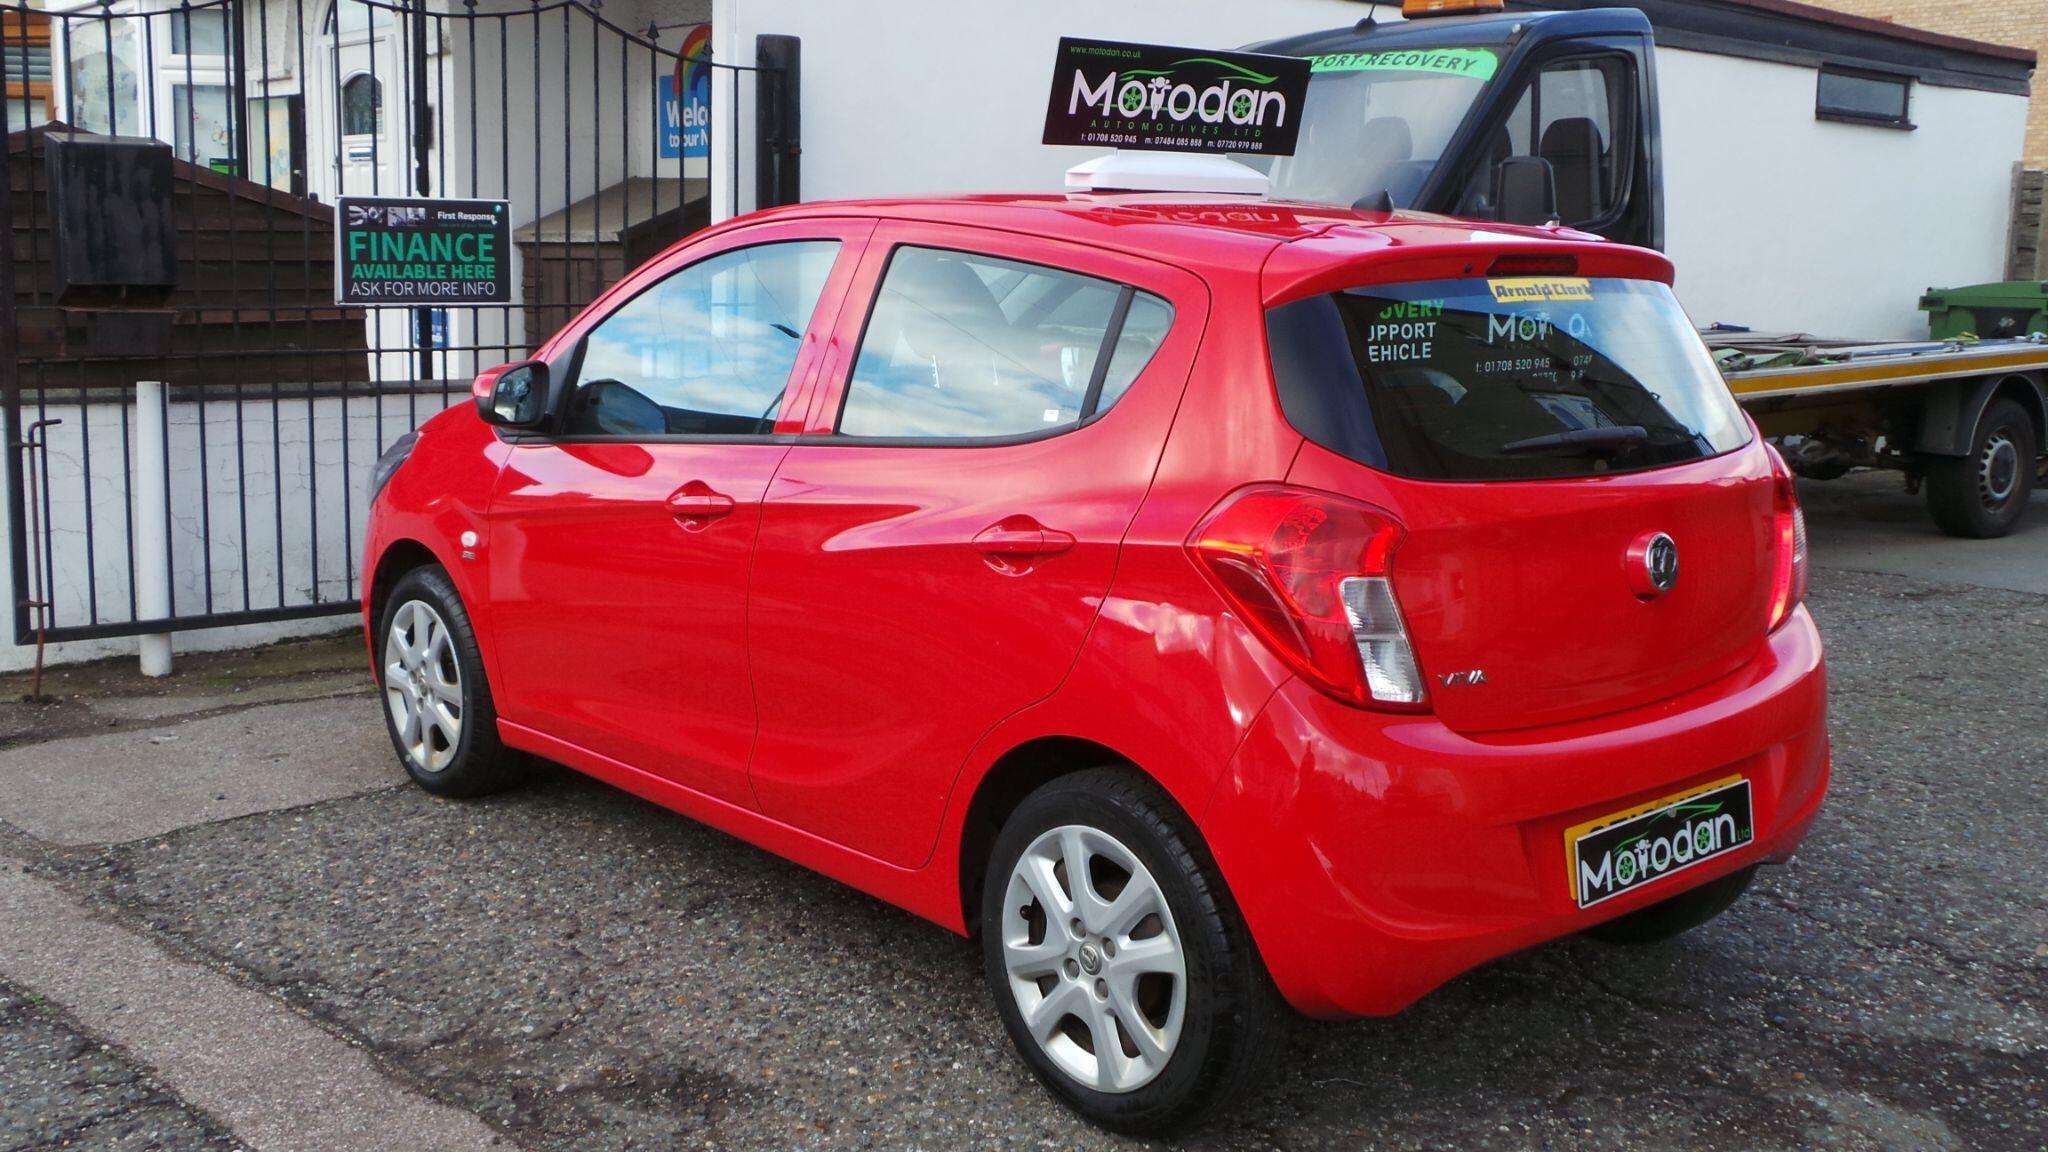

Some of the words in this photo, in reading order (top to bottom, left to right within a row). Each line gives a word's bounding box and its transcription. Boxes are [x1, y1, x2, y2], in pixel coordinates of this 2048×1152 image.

[1070, 46, 1141, 58] www.motodan.co.uk
[1309, 53, 1477, 71] PORT-RECOVERY
[1090, 120, 1219, 134] AUTOMOTIVES
[1234, 128, 1261, 137] LTD
[1087, 133, 1109, 142] 01708
[1110, 134, 1123, 143] 520
[1124, 135, 1137, 144] 945
[437, 211, 456, 220] First
[350, 231, 495, 262] FINANCE
[352, 264, 447, 279] AVAILABLE
[451, 265, 496, 279] HERE
[350, 281, 381, 296] ASK
[385, 282, 414, 296] FOR
[418, 282, 459, 296] MORE
[463, 281, 496, 296] INFO
[1484, 360, 1512, 372] 01708
[1515, 359, 1532, 370] 520
